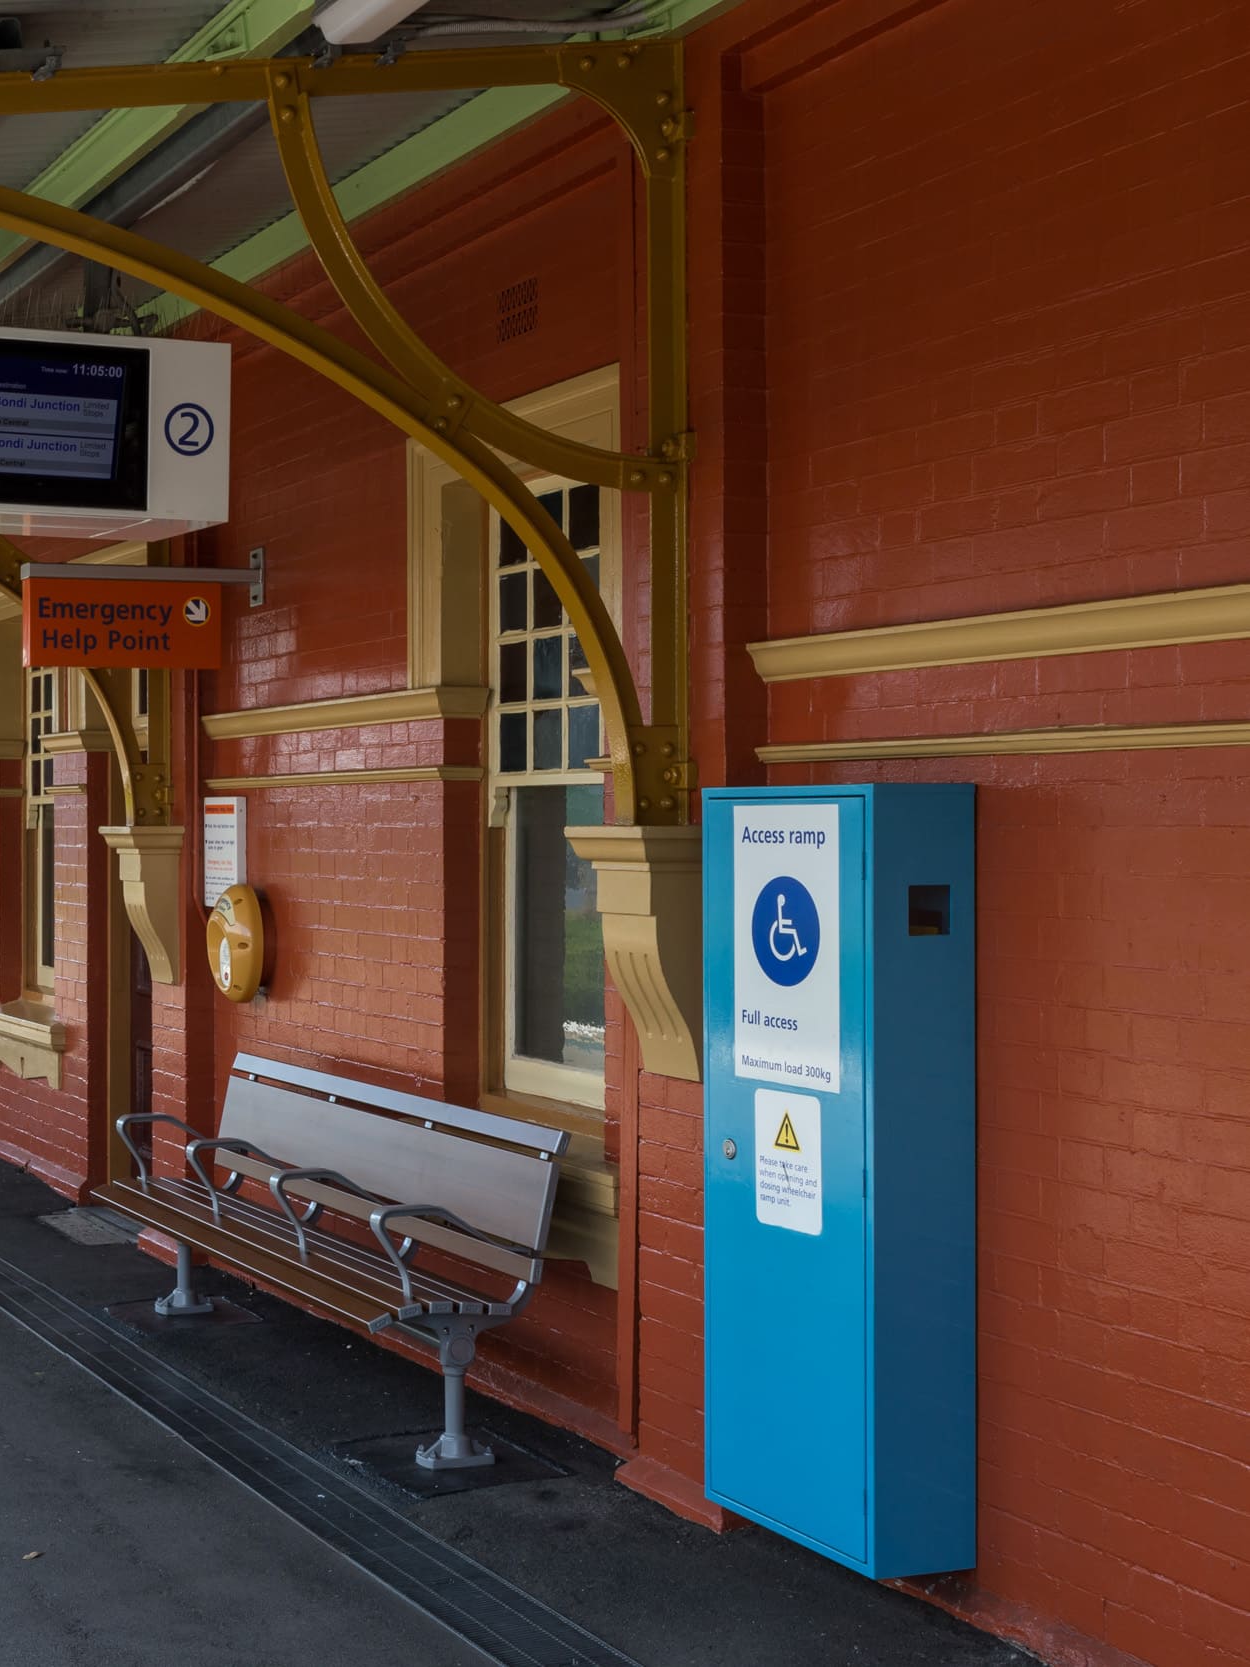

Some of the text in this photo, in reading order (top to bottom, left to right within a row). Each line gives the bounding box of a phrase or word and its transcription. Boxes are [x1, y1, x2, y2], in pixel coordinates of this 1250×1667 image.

[72, 363, 123, 378] 11:05:00
[30, 398, 81, 412] Junction
[83, 401, 110, 411] Limited
[83, 409, 104, 418] Stops
[178, 411, 200, 446] 2
[26, 439, 77, 453] Junction
[80, 441, 106, 450] Limited
[38, 596, 173, 627] Emergency
[41, 628, 171, 656] Help Point
[741, 826, 826, 850] Access ramp
[741, 1009, 798, 1031] Full access
[741, 1055, 832, 1083] Maximum load 300kg
[759, 1155, 808, 1173] Please take care
[759, 1168, 777, 1179] when
[804, 1177, 818, 1188] and
[760, 1180, 816, 1200] closing wheelchair
[760, 1194, 776, 1204] ramp
